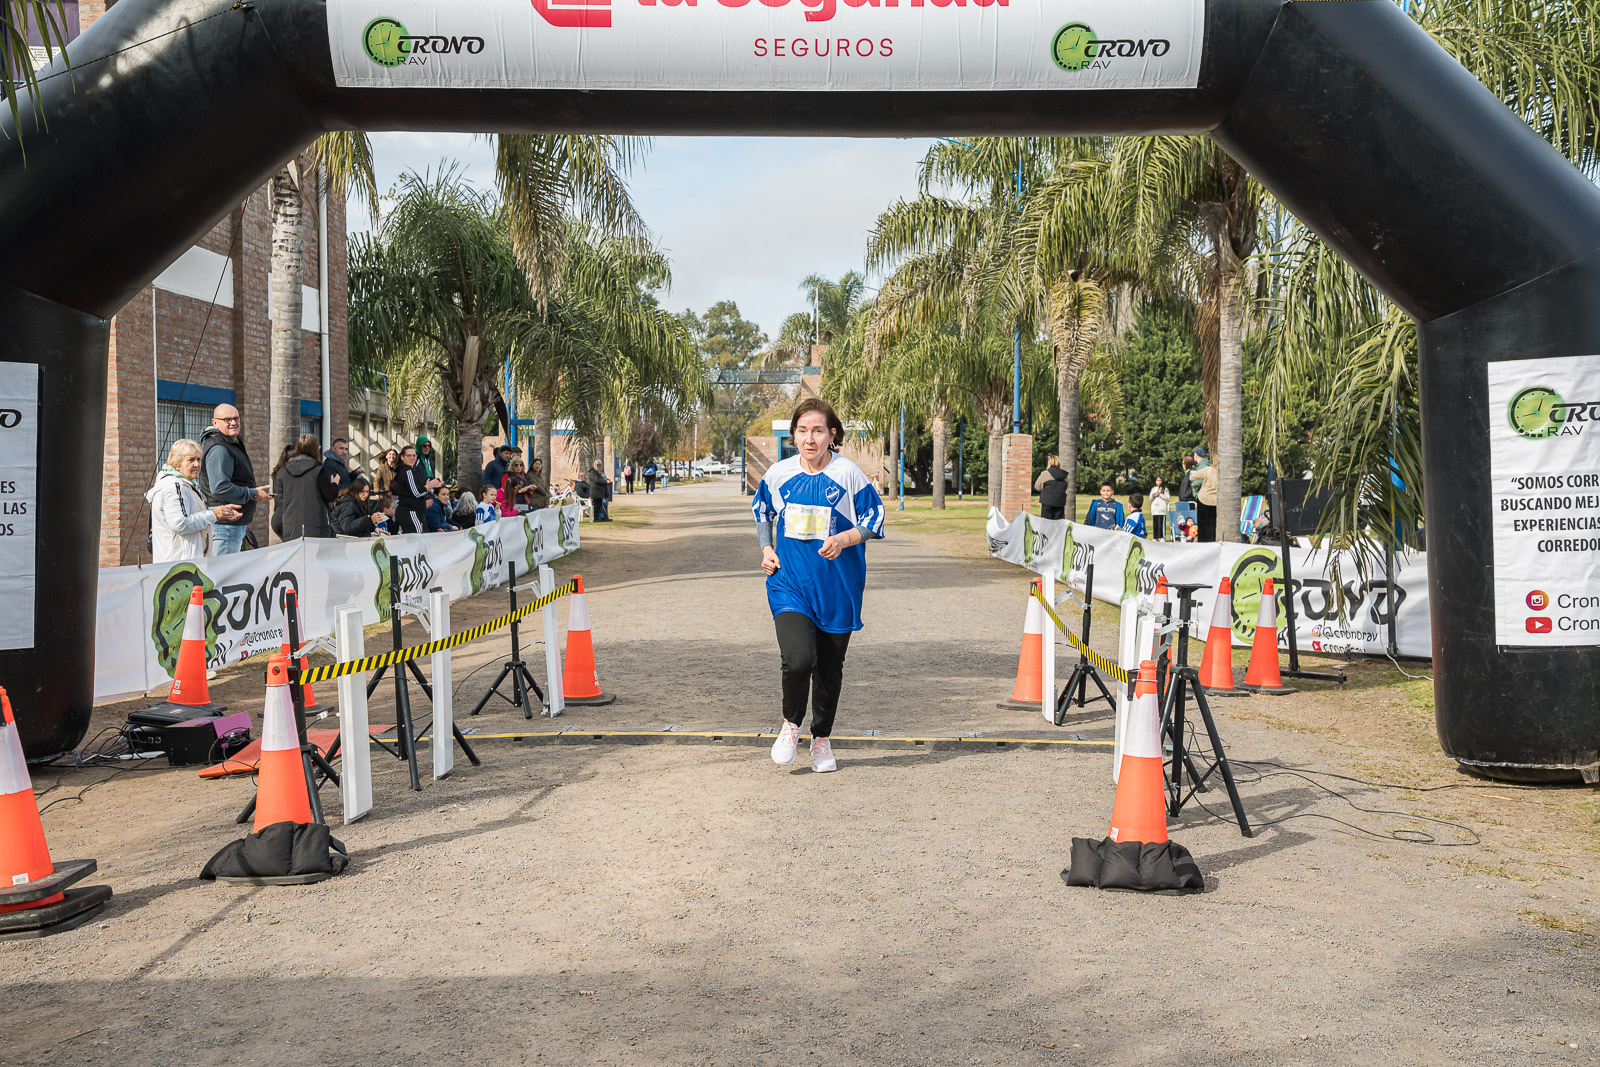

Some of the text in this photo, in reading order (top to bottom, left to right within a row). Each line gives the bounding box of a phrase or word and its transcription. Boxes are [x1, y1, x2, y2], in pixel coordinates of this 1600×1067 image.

[397, 35, 485, 54] CRONO
[753, 38, 894, 57] SEGUROS
[1084, 39, 1171, 58] CRONO
[397, 56, 428, 66] RAV
[1081, 60, 1111, 69] RAV
[1548, 425, 1584, 437] RAV
[1567, 474, 1600, 488] CORR
[3, 502, 27, 515] LAS
[1501, 496, 1600, 512] BUSCANDO MEJ
[789, 513, 824, 533] 735
[1537, 538, 1600, 553] CORREDO
